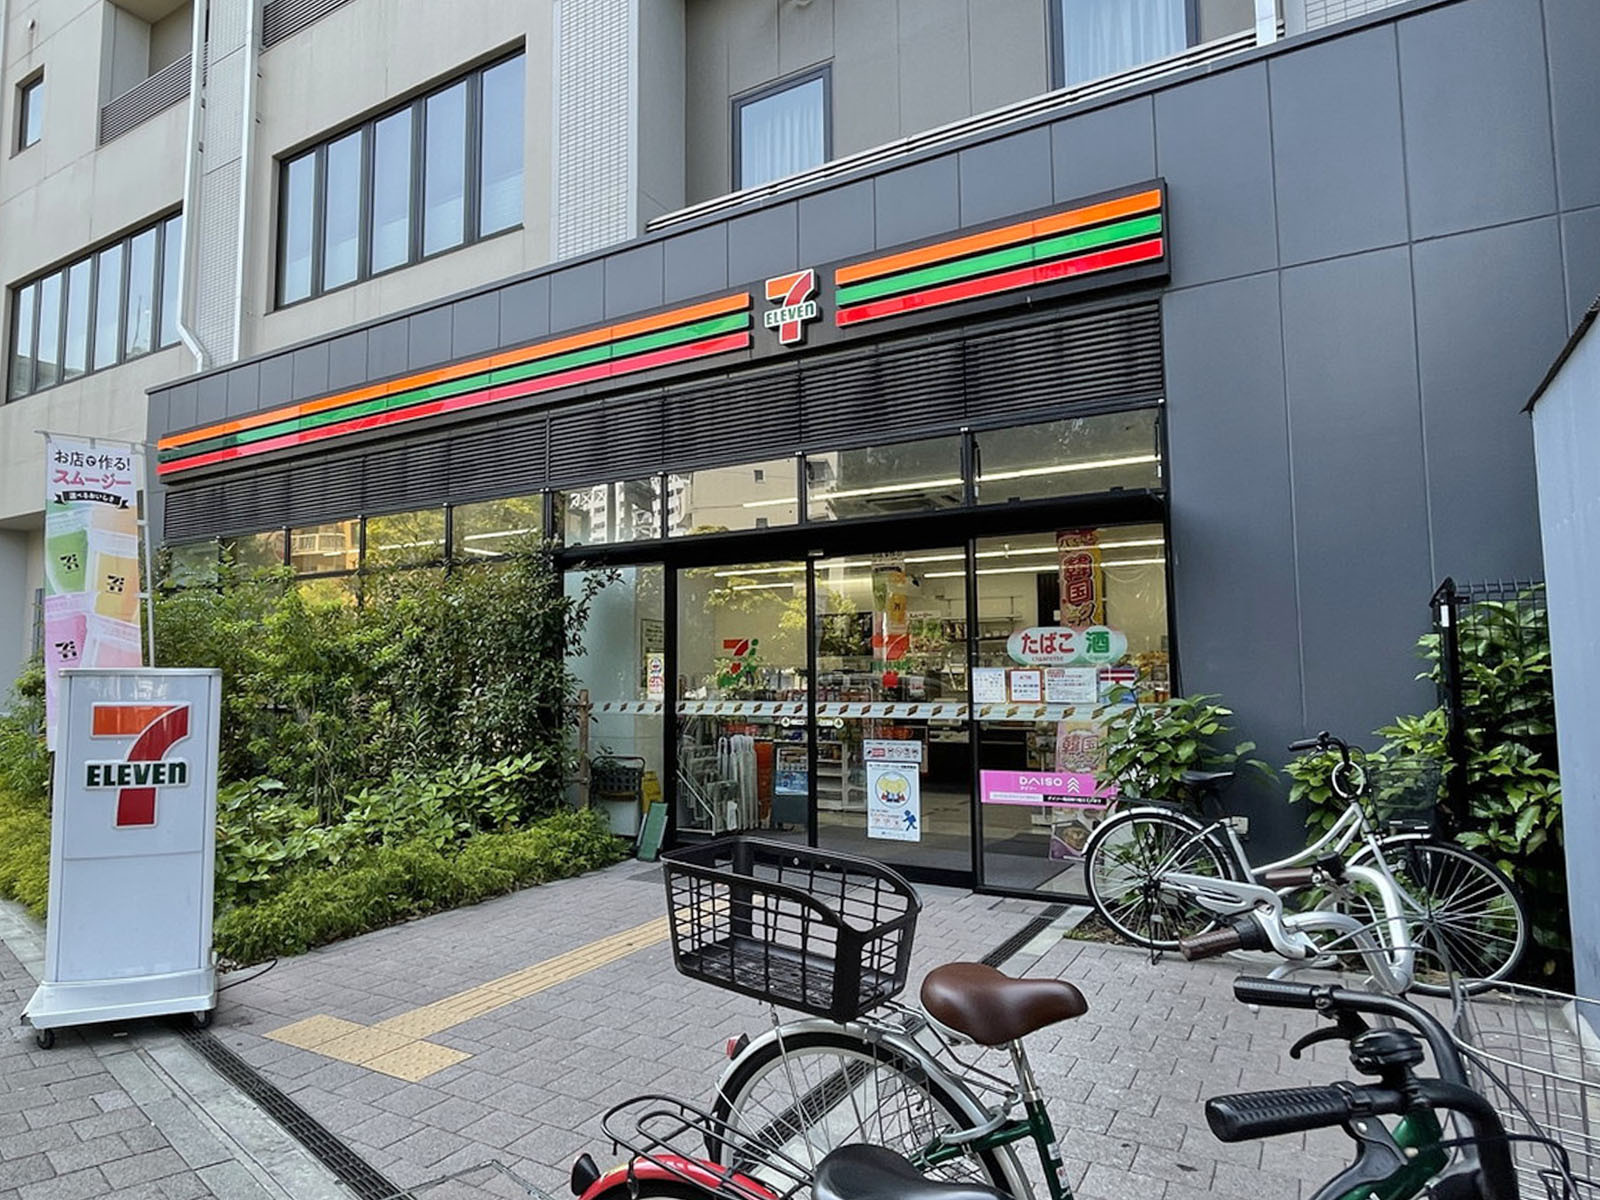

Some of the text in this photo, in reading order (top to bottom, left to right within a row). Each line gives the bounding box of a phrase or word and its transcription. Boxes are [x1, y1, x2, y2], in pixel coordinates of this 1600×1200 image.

[53, 469, 131, 489] スムージー
[1021, 631, 1110, 655] たばこ 酒
[92, 705, 189, 827] 7
[1019, 776, 1062, 786] DAISO
